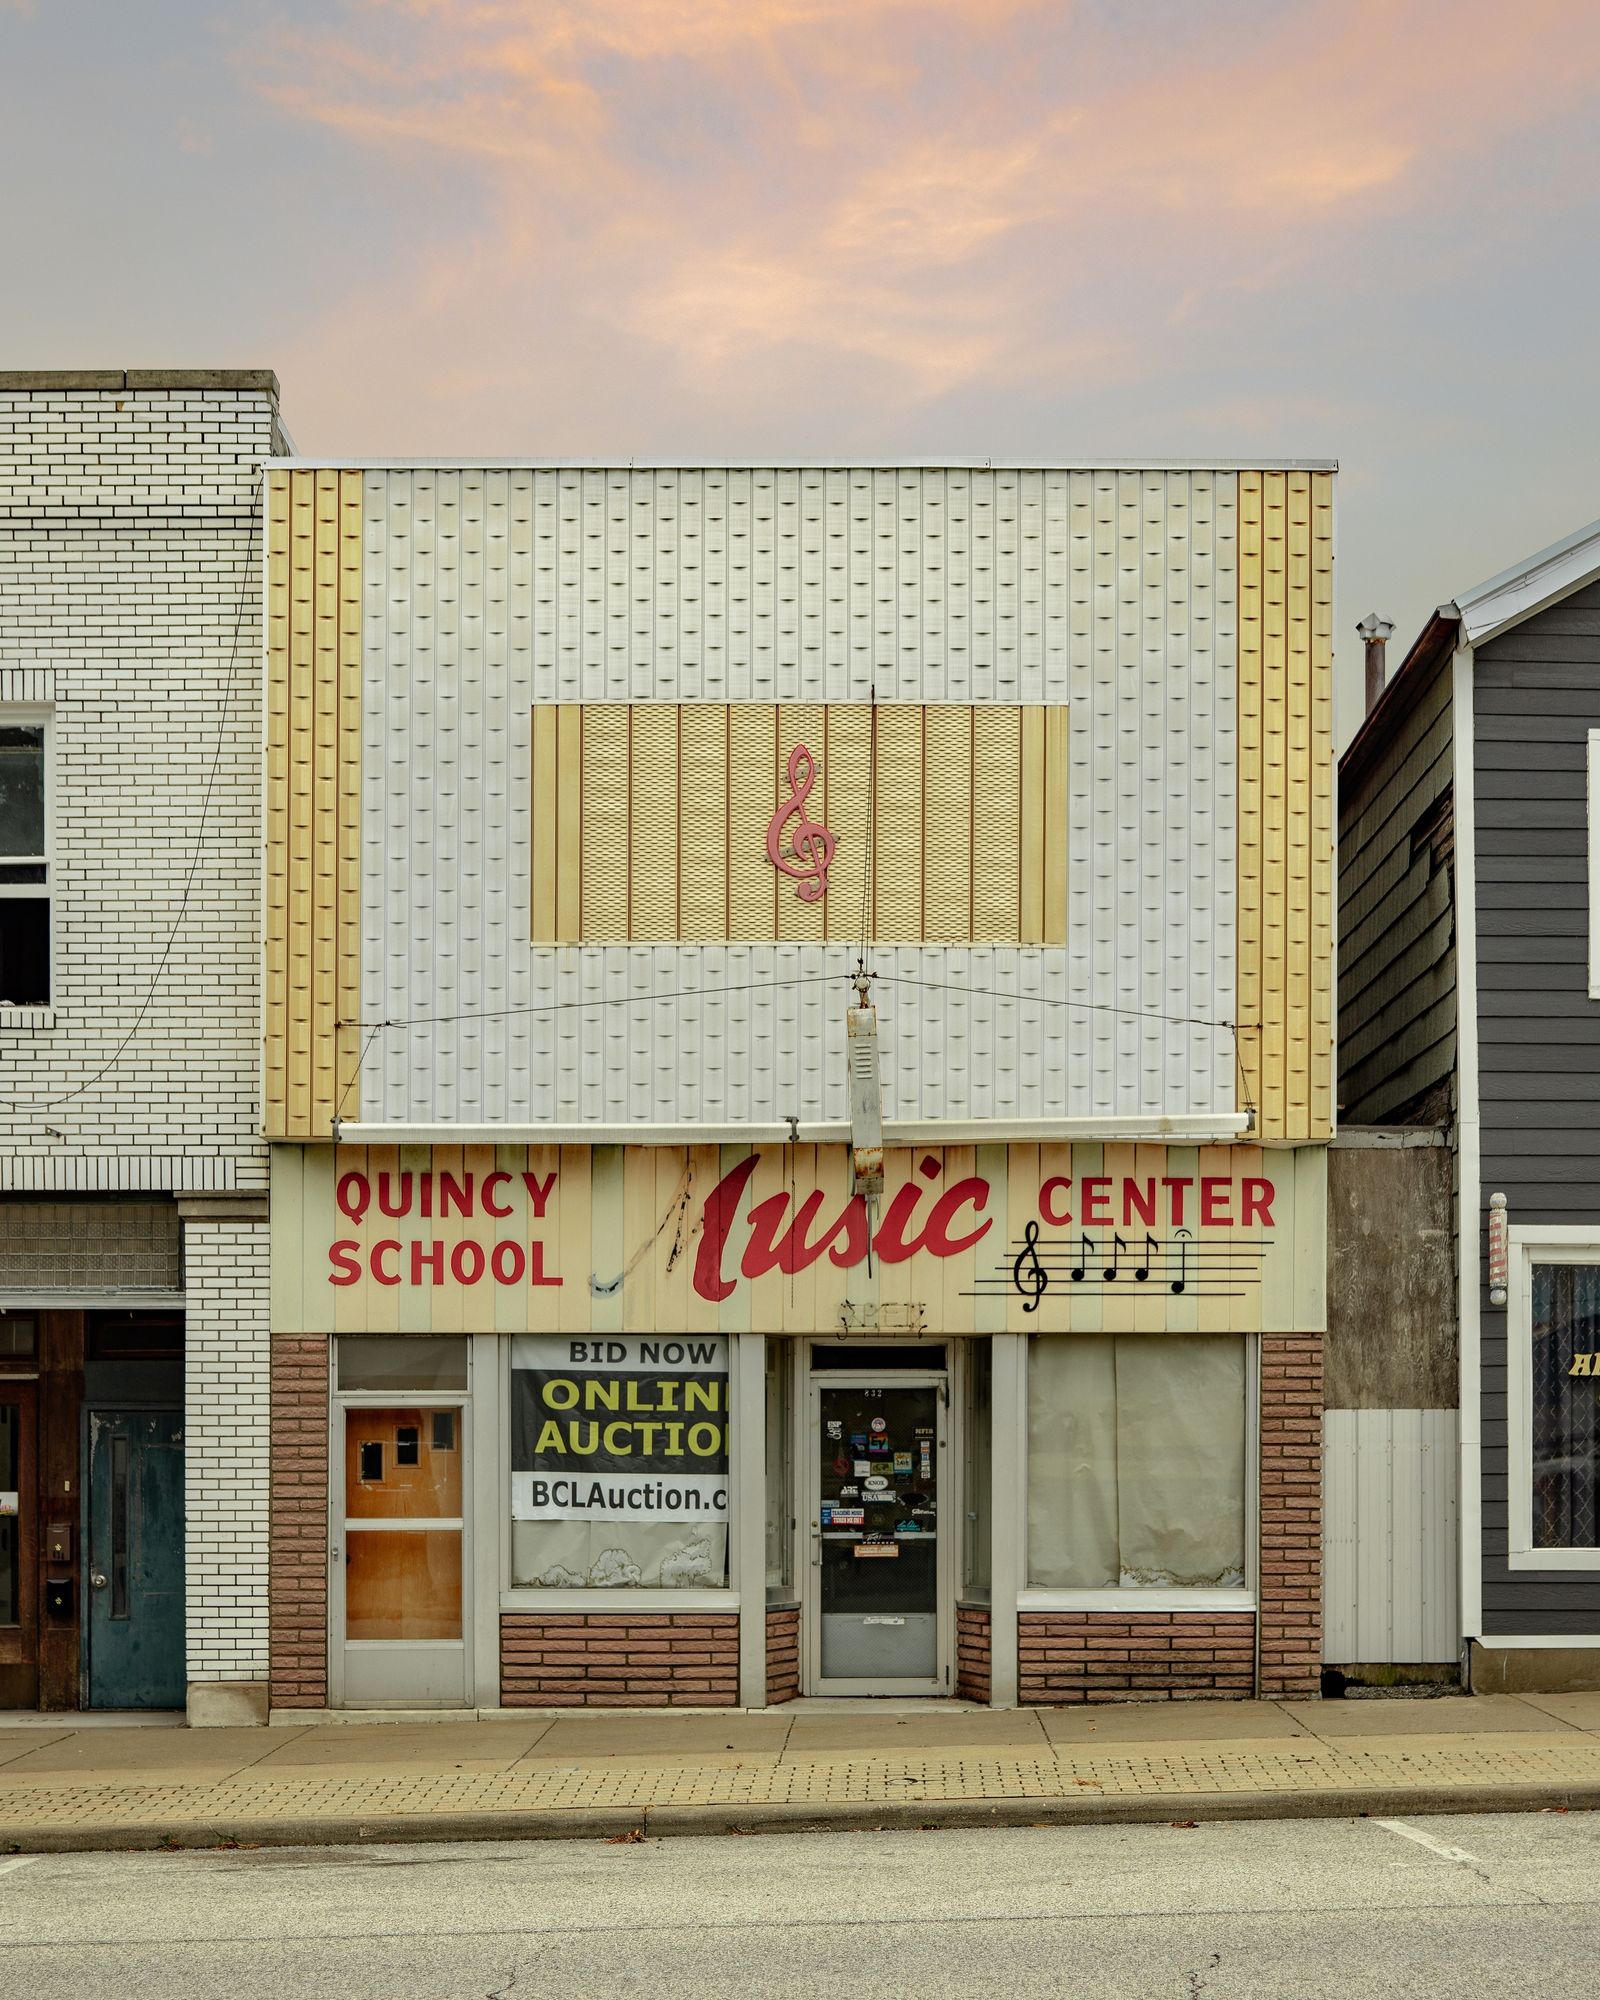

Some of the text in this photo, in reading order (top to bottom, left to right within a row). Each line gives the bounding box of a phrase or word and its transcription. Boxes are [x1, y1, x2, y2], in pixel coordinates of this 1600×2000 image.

[336, 1172, 558, 1226] QUINCY
[1038, 1175, 1276, 1228] CENTER
[328, 1239, 564, 1287] SCHOOL
[569, 1341, 717, 1364] BID NOW
[542, 1379, 729, 1412] ONLIN
[534, 1420, 729, 1457] AUCTIO
